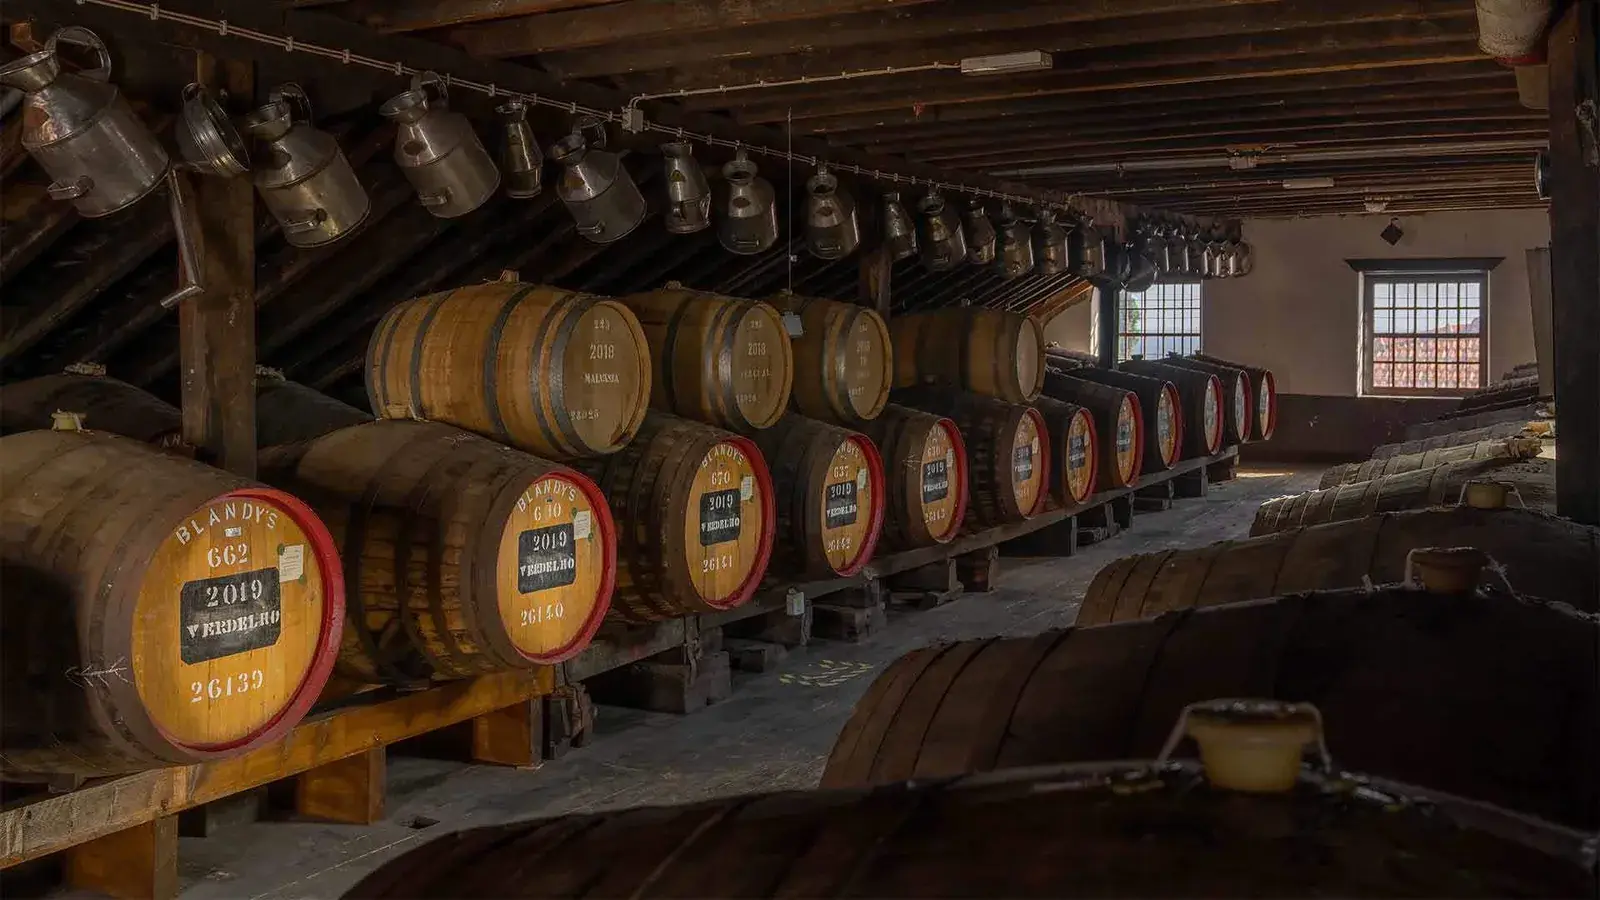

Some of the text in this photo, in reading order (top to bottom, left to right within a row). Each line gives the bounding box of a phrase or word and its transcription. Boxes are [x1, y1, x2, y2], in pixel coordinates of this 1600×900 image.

[589, 344, 615, 360] 2018
[926, 461, 945, 476] 2019
[711, 471, 731, 486] 670
[516, 479, 577, 513] BLANDY'S
[831, 482, 852, 498] 2019
[709, 494, 733, 511] 2019
[175, 502, 279, 546] BLANDY'S
[701, 517, 740, 532] VERDELHO
[533, 531, 567, 551] 2019
[207, 543, 249, 568] 662
[702, 555, 733, 573] 26141
[520, 558, 575, 577] VERDELHO
[206, 579, 263, 607] 2019
[521, 602, 564, 626] 26140
[186, 610, 281, 639] VERDELHO
[190, 669, 264, 703] 26139
